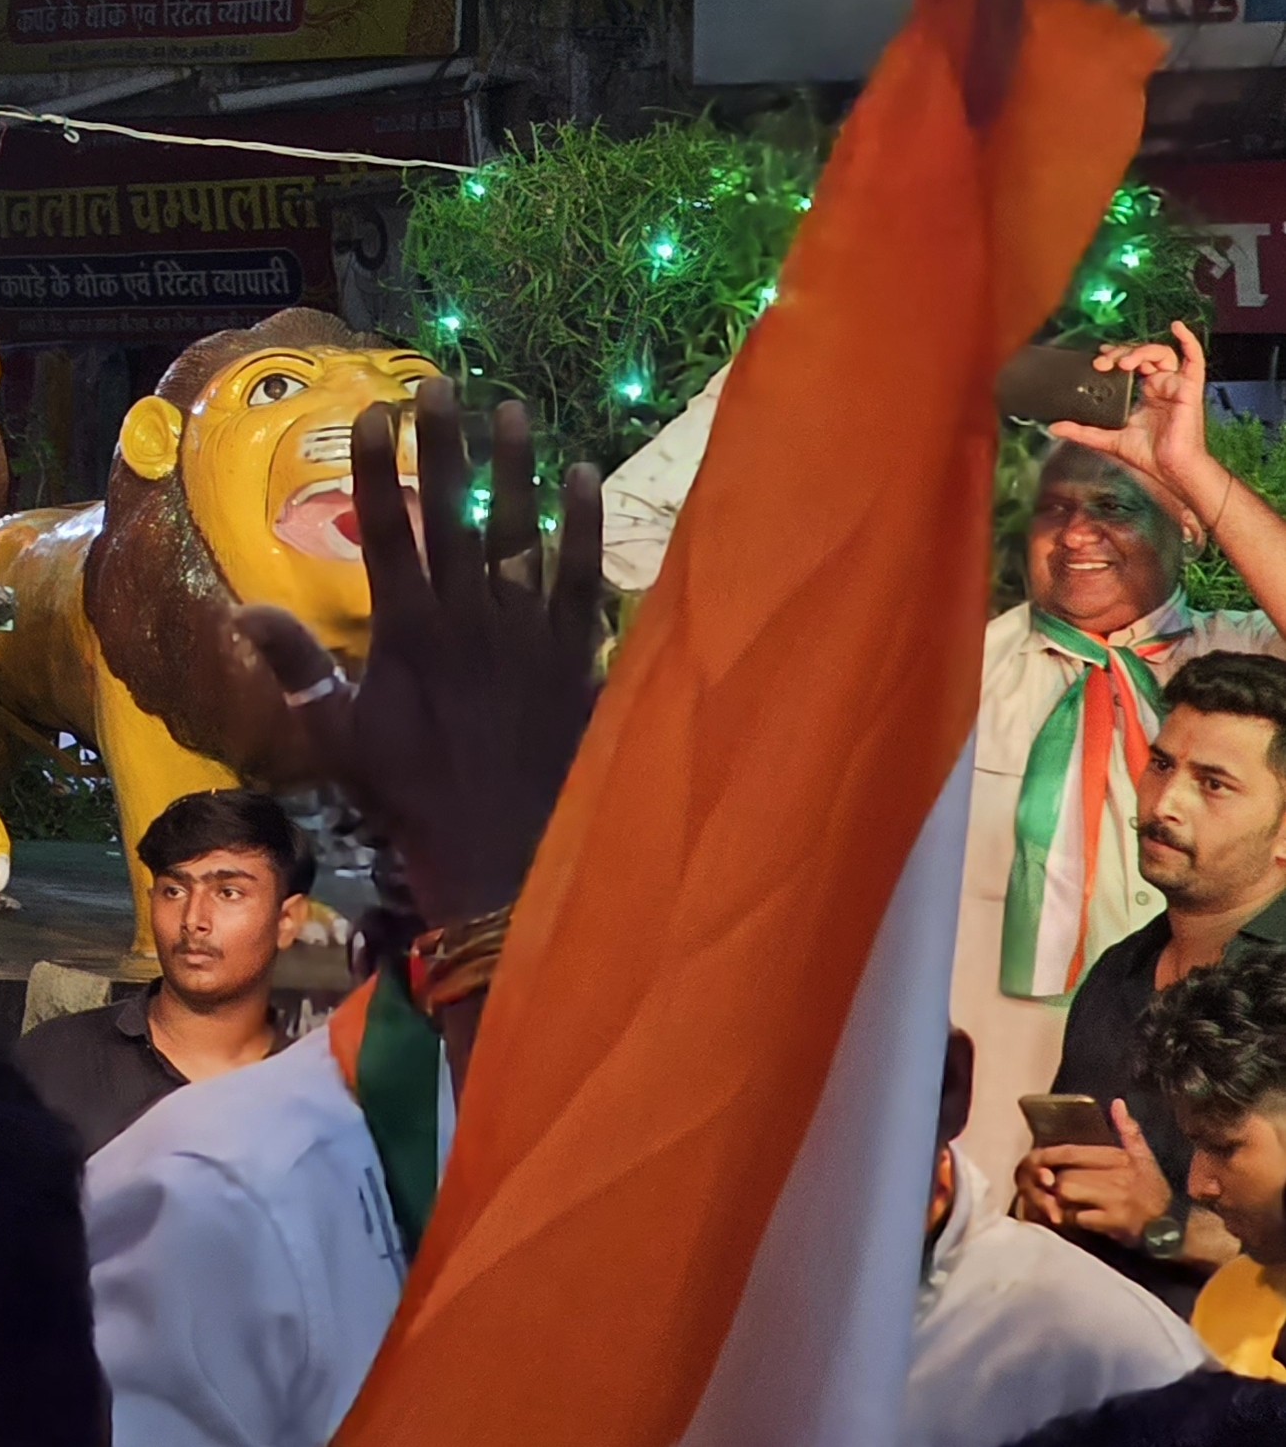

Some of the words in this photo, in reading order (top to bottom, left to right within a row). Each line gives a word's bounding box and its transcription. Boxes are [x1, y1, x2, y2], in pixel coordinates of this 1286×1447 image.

[127, 175, 319, 236] चम्पालाल
[49, 264, 71, 298] के
[75, 263, 119, 298] थोक
[122, 261, 152, 302] एवं
[210, 255, 291, 297] व्यापारी
